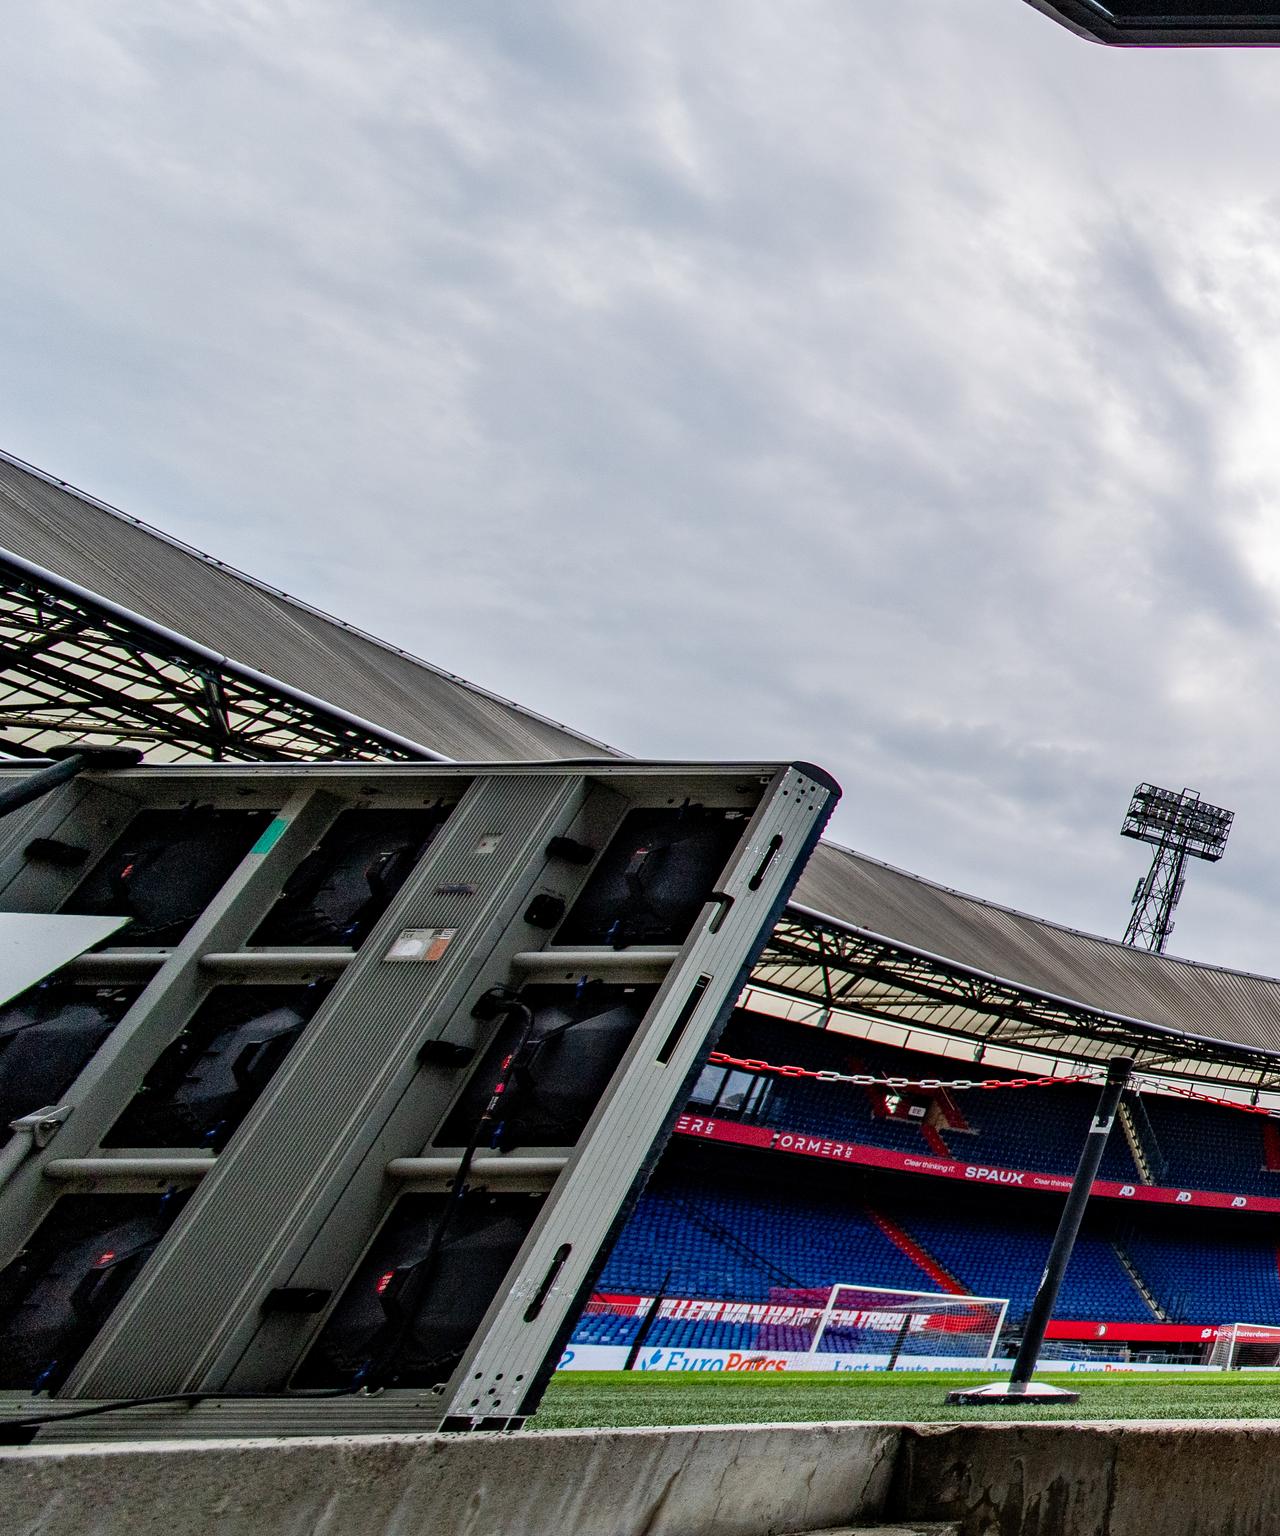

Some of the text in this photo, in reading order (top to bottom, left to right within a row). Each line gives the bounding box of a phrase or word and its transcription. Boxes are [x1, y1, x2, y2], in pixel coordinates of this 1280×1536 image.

[904, 1159, 921, 1167] Clear
[922, 1161, 947, 1172] thinking
[965, 1166, 1025, 1184] SPAUX
[1119, 1185, 1135, 1196] AD
[1176, 1192, 1191, 1202] AD
[1231, 1197, 1246, 1207] AD
